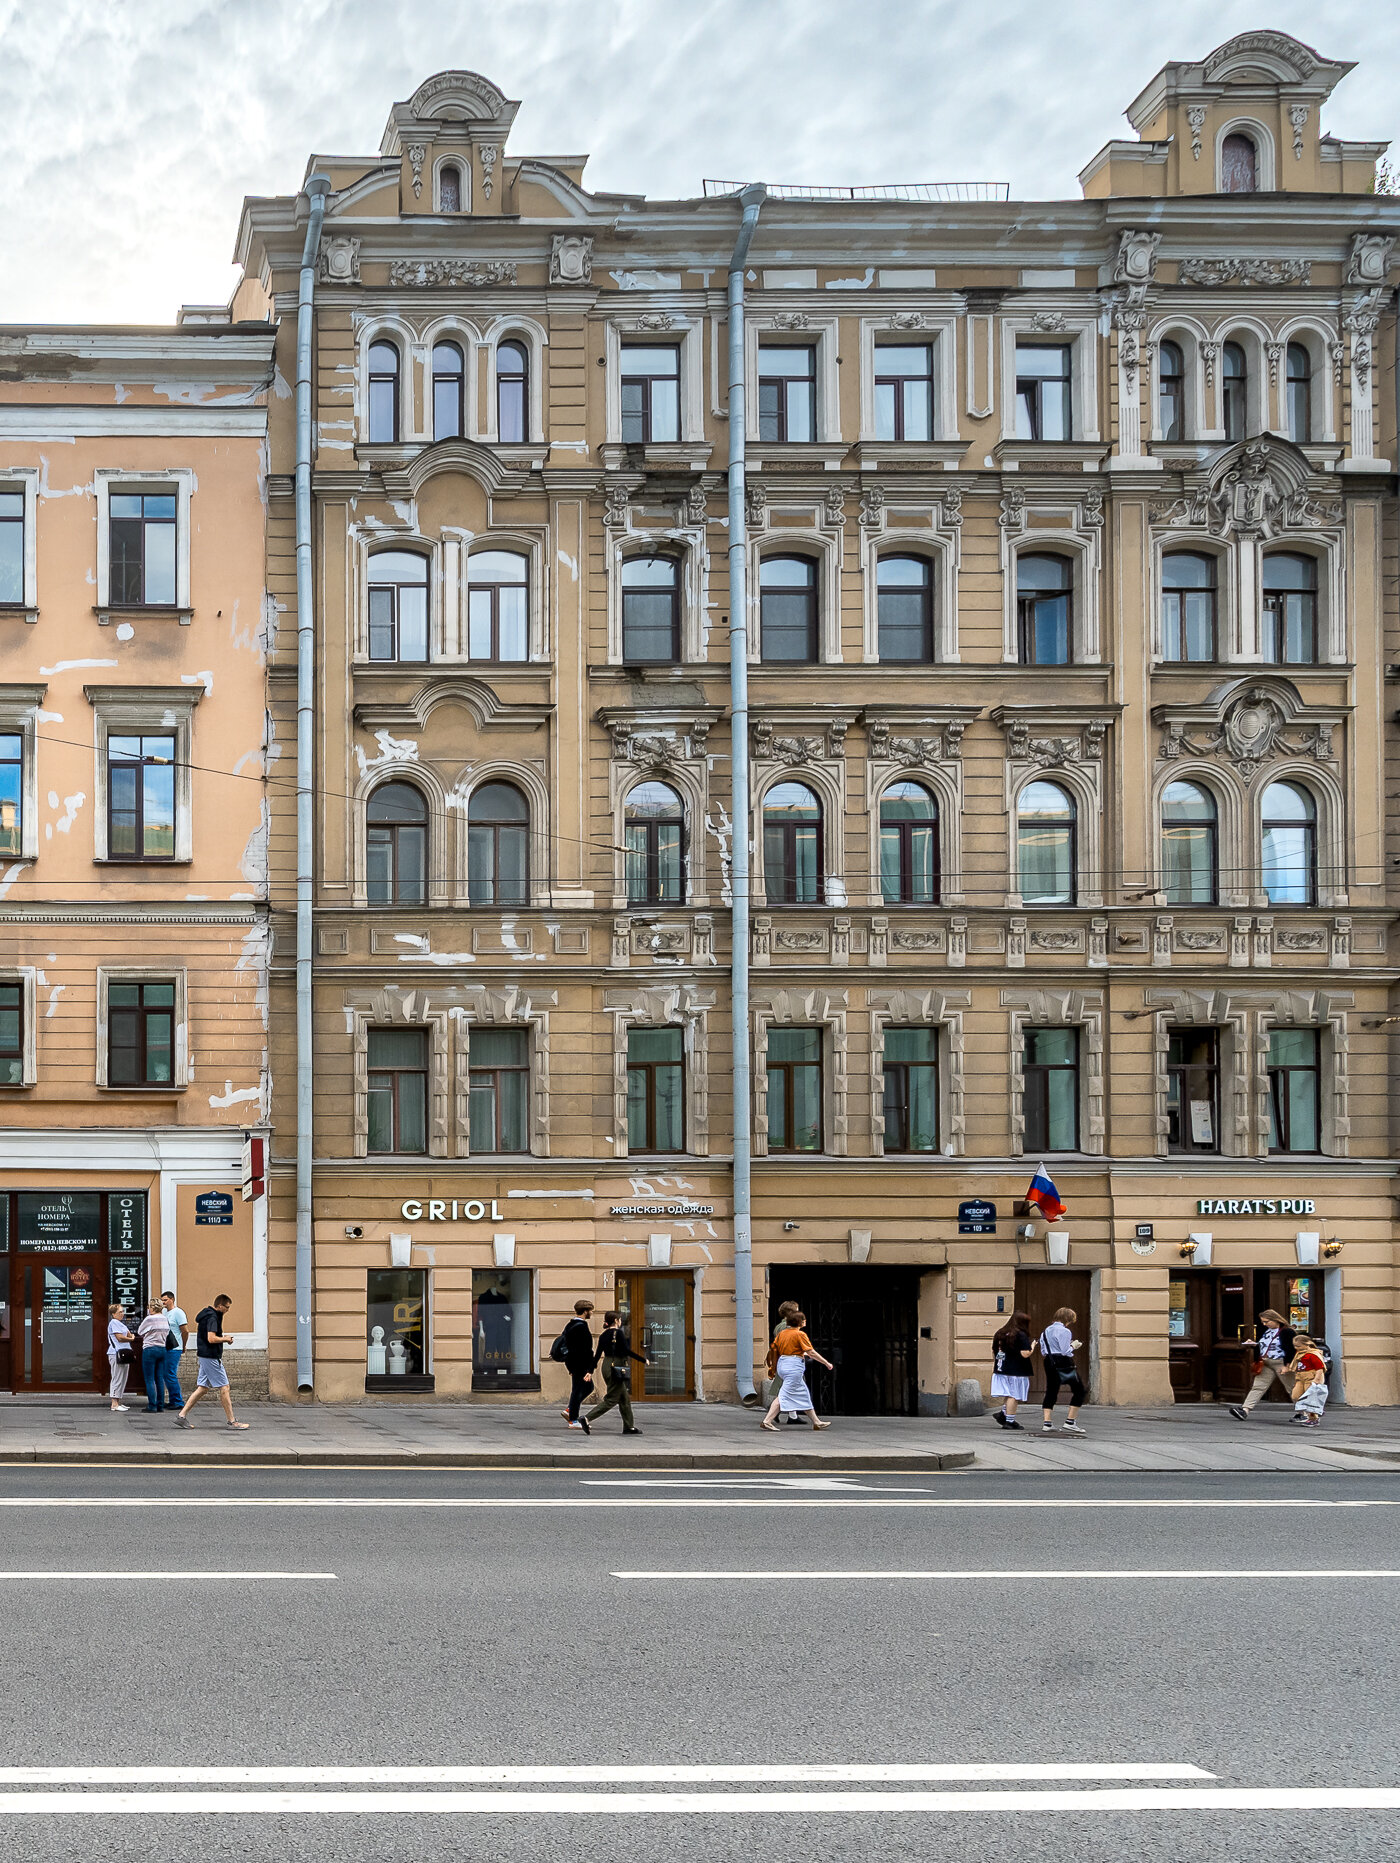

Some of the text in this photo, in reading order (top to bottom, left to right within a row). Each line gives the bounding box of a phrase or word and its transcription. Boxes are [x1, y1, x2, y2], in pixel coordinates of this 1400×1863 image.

[401, 1199, 504, 1221] GRIOL
[611, 1205, 714, 1215] женская одежда
[964, 1207, 991, 1215] НЕВСКИЙ
[1199, 1199, 1316, 1214] HARAT'S PUB
[120, 1198, 133, 1249] ОТЕЛЬ
[115, 1267, 138, 1315] HOTEL
